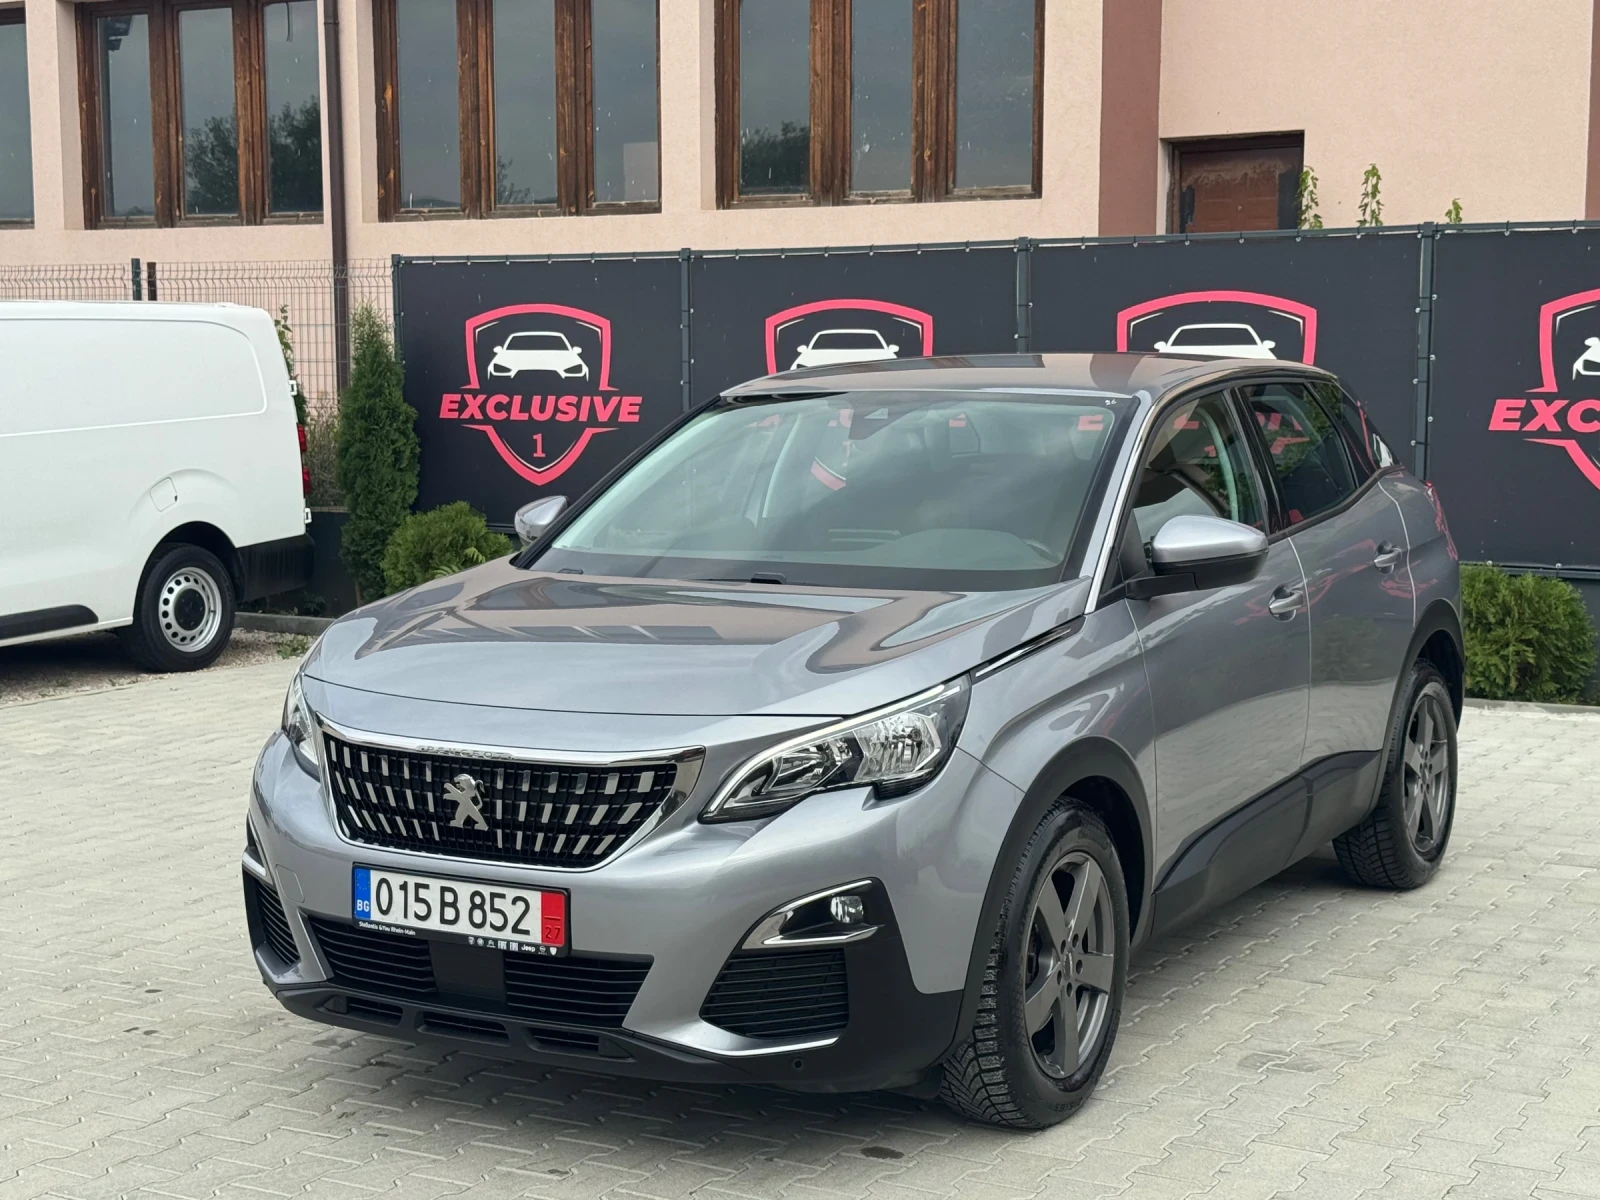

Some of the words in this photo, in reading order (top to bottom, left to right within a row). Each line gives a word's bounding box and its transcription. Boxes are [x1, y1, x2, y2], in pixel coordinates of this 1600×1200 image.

[439, 394, 642, 422] EXCLUSIVE
[533, 433, 546, 457] 1
[356, 899, 370, 912] BG
[545, 925, 561, 940] 27
[521, 944, 536, 953] Jeep
